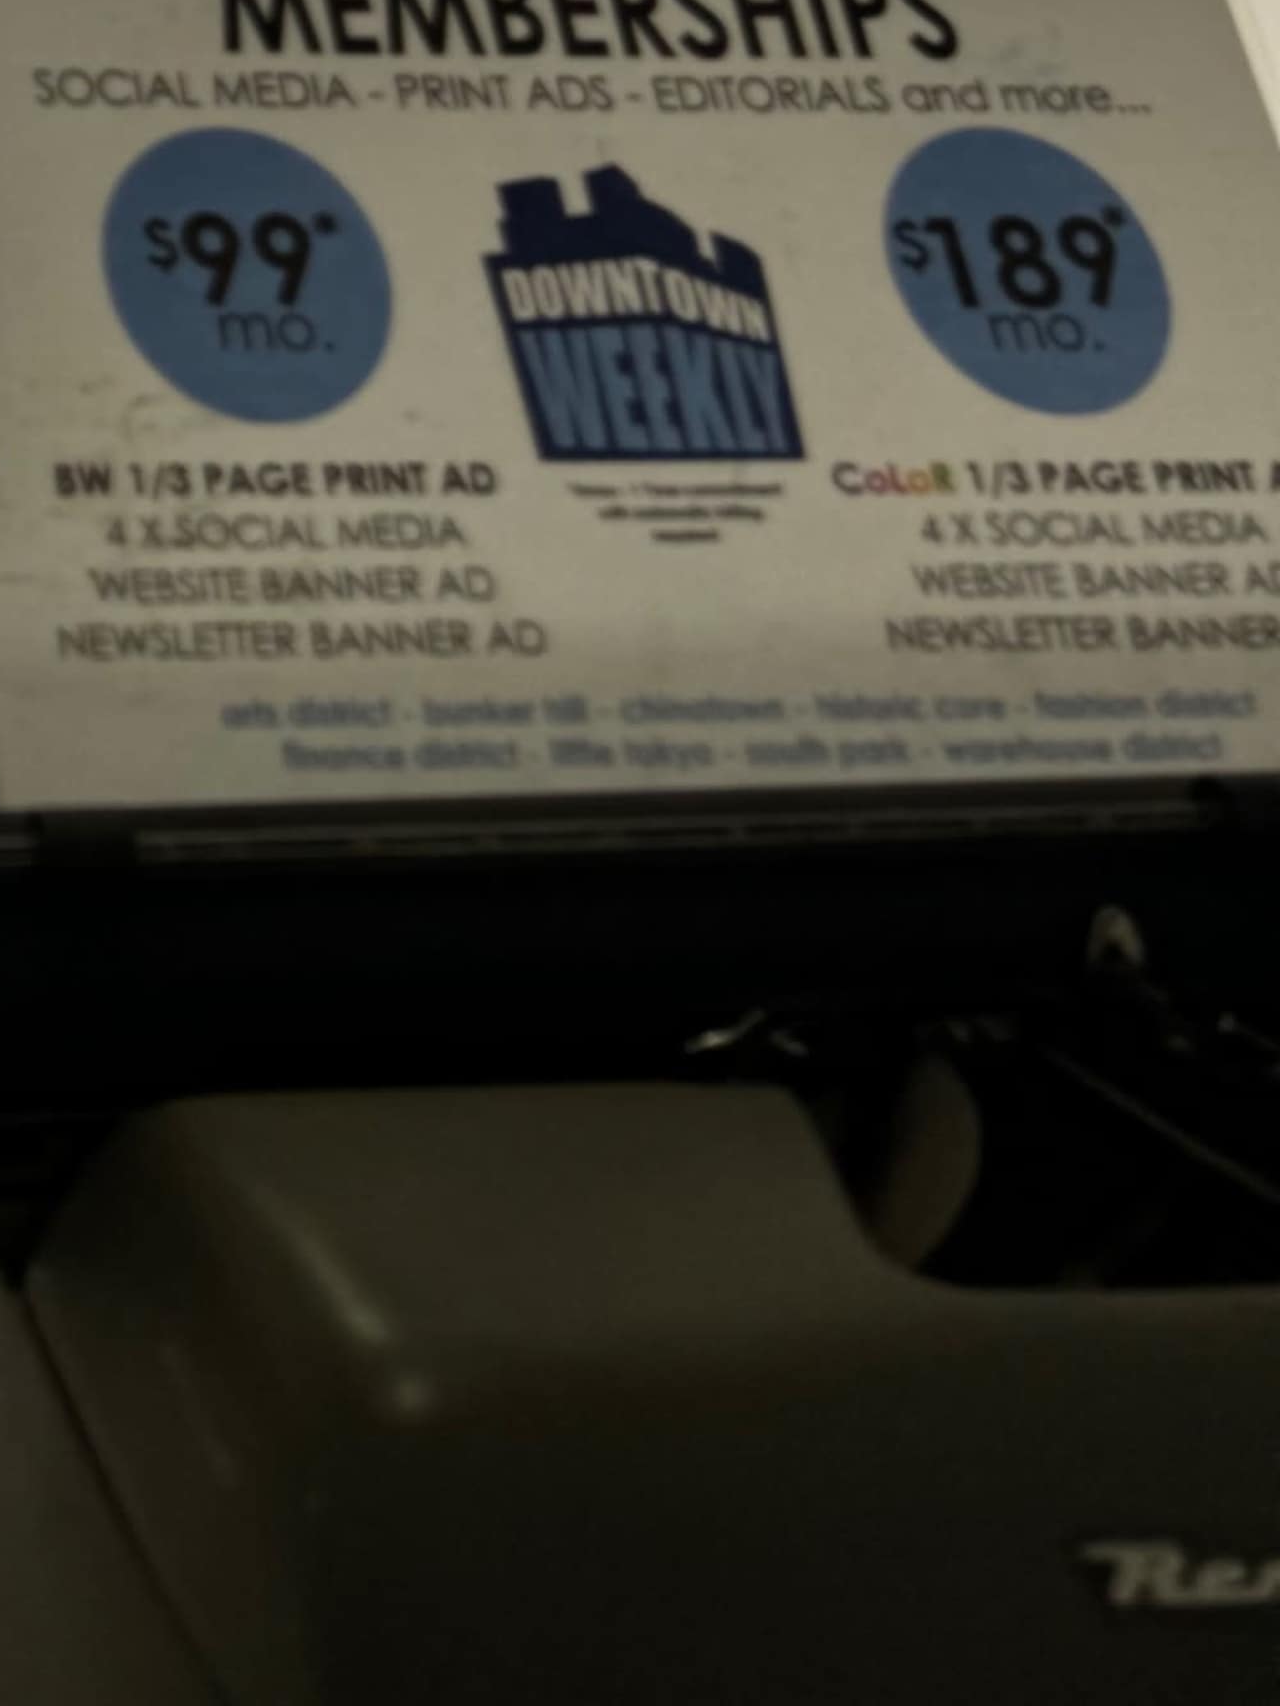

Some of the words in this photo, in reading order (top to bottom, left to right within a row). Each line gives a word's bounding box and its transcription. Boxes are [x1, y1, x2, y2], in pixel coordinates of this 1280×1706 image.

[34, 68, 200, 111] SOCIAL
[213, 72, 357, 110] MEDIA
[395, 72, 513, 111] PRINT
[528, 75, 614, 113] ADS
[654, 75, 892, 116] EDITORIALS
[902, 77, 990, 116] and
[501, 254, 772, 344] DOWNTOWN
[217, 311, 336, 353] mo.
[987, 312, 1107, 354] mo.
[516, 324, 790, 453] WEEKLY
[128, 463, 192, 501] 1/3
[203, 461, 314, 497] PAGE
[323, 462, 427, 497] PRINT
[442, 462, 497, 497] AD
[1039, 459, 1144, 494] PAGE
[1153, 459, 1257, 493] PRINT
[172, 513, 326, 552] SOCIAL
[336, 514, 468, 551] MEDIA
[985, 510, 1133, 547] SOCIAL
[1143, 510, 1269, 544] MEDIA
[88, 566, 251, 604] WEBSITE
[260, 566, 423, 604] BANNER
[436, 566, 497, 602] AD
[911, 562, 1069, 598] WEBSITE
[1071, 562, 1231, 597] BANNER
[56, 622, 297, 662] NEWSLETTER
[311, 620, 471, 661] BANNER
[487, 620, 549, 660] AD
[884, 614, 1119, 654] NEWSLETTER
